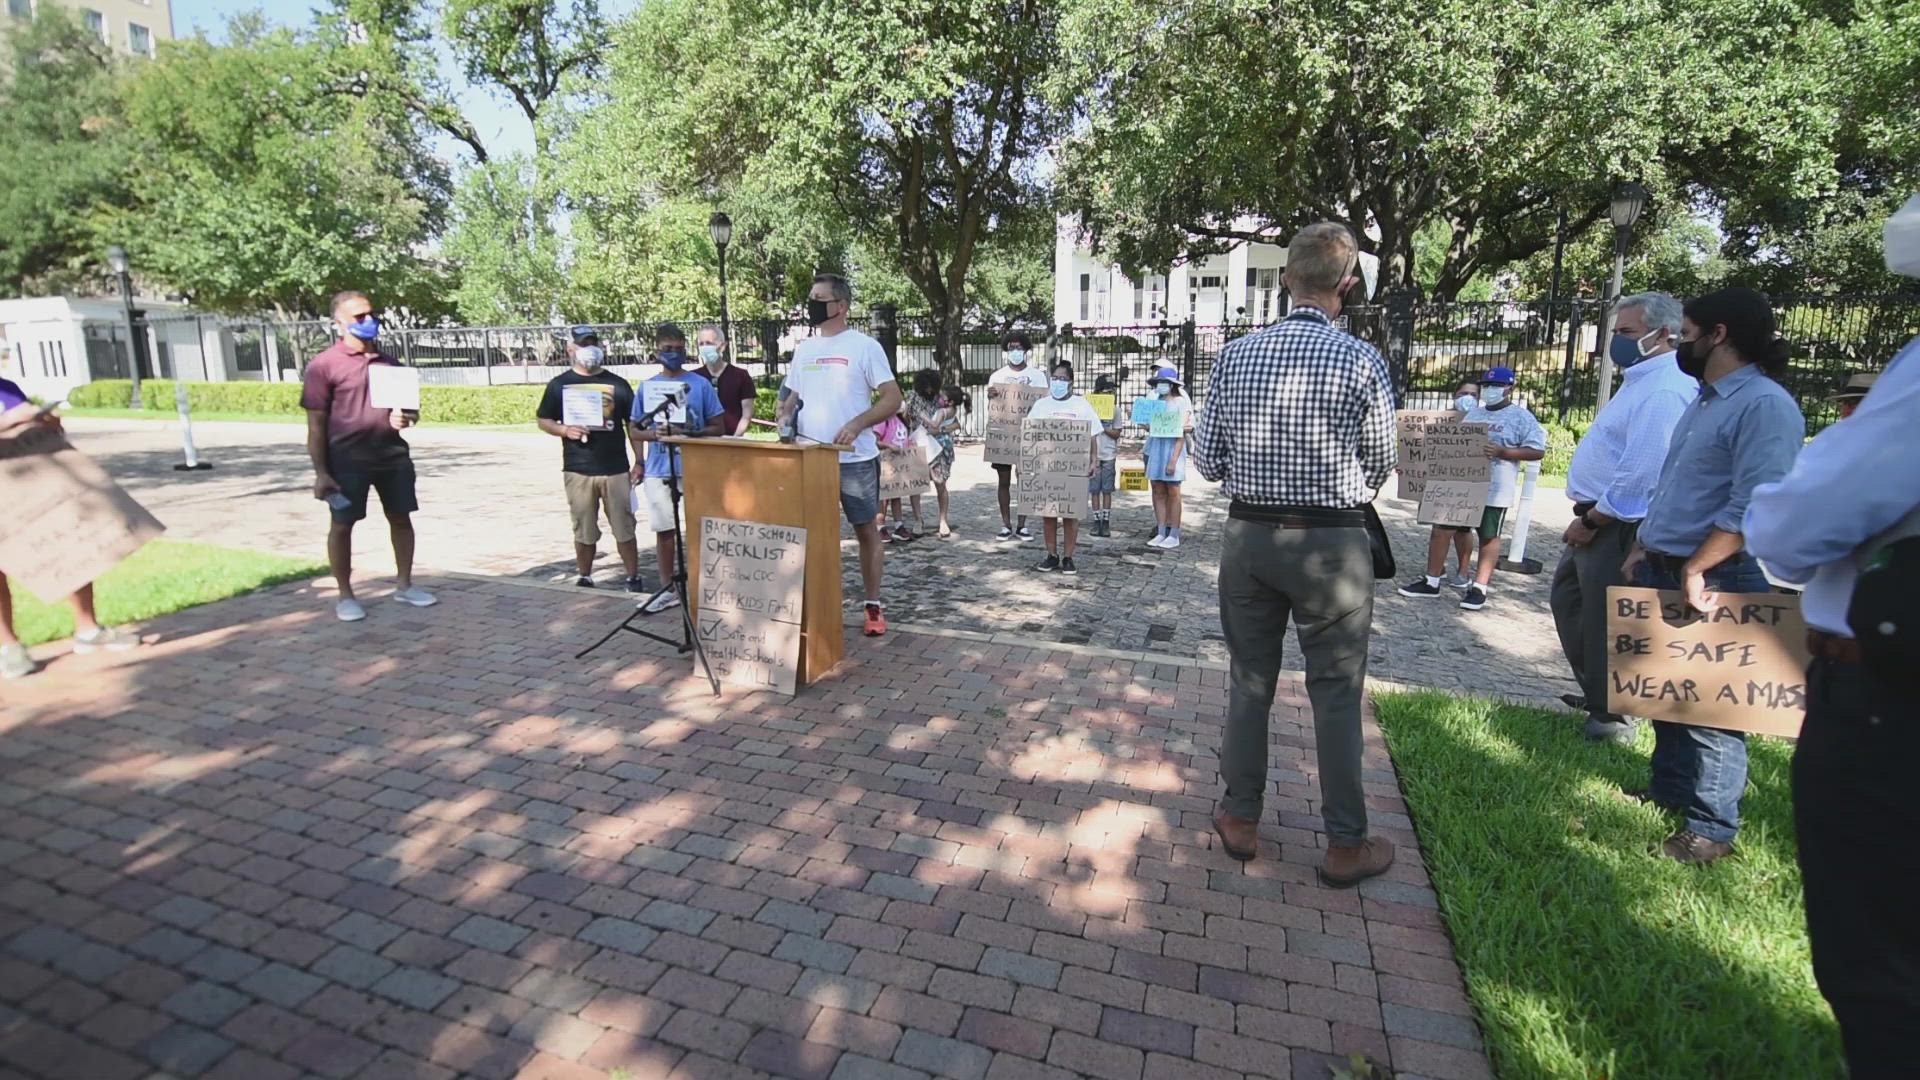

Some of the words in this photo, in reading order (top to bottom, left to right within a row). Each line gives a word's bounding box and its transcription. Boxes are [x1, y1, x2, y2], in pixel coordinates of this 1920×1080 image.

[1024, 421, 1048, 431] Back
[1060, 421, 1089, 432] School
[1403, 415, 1429, 424] STOP
[1405, 425, 1424, 433] SPR
[1426, 425, 1451, 436] BACK
[1451, 425, 1459, 435] 2
[1460, 425, 1486, 436] SCHOOL
[1047, 460, 1068, 472] KIDS
[1033, 480, 1052, 492] Safe
[1053, 482, 1066, 491] and
[1436, 487, 1454, 498] Safe
[1456, 487, 1470, 497] and
[1050, 502, 1075, 514] ALL
[705, 519, 738, 537] BACK
[740, 524, 754, 537] TO
[758, 527, 800, 545] SCHOOL
[721, 565, 750, 582] Follow
[753, 569, 776, 582] CDC
[736, 593, 764, 610] KIDS
[1616, 597, 1650, 619] BE
[720, 624, 745, 640] Safe
[748, 632, 766, 645] and
[1615, 634, 1652, 655] BE
[1665, 640, 1759, 667] SAFE
[742, 648, 785, 668] Schools
[1612, 671, 1700, 703] WEAR
[1716, 684, 1739, 705] A
[1747, 680, 1807, 710] MAS
